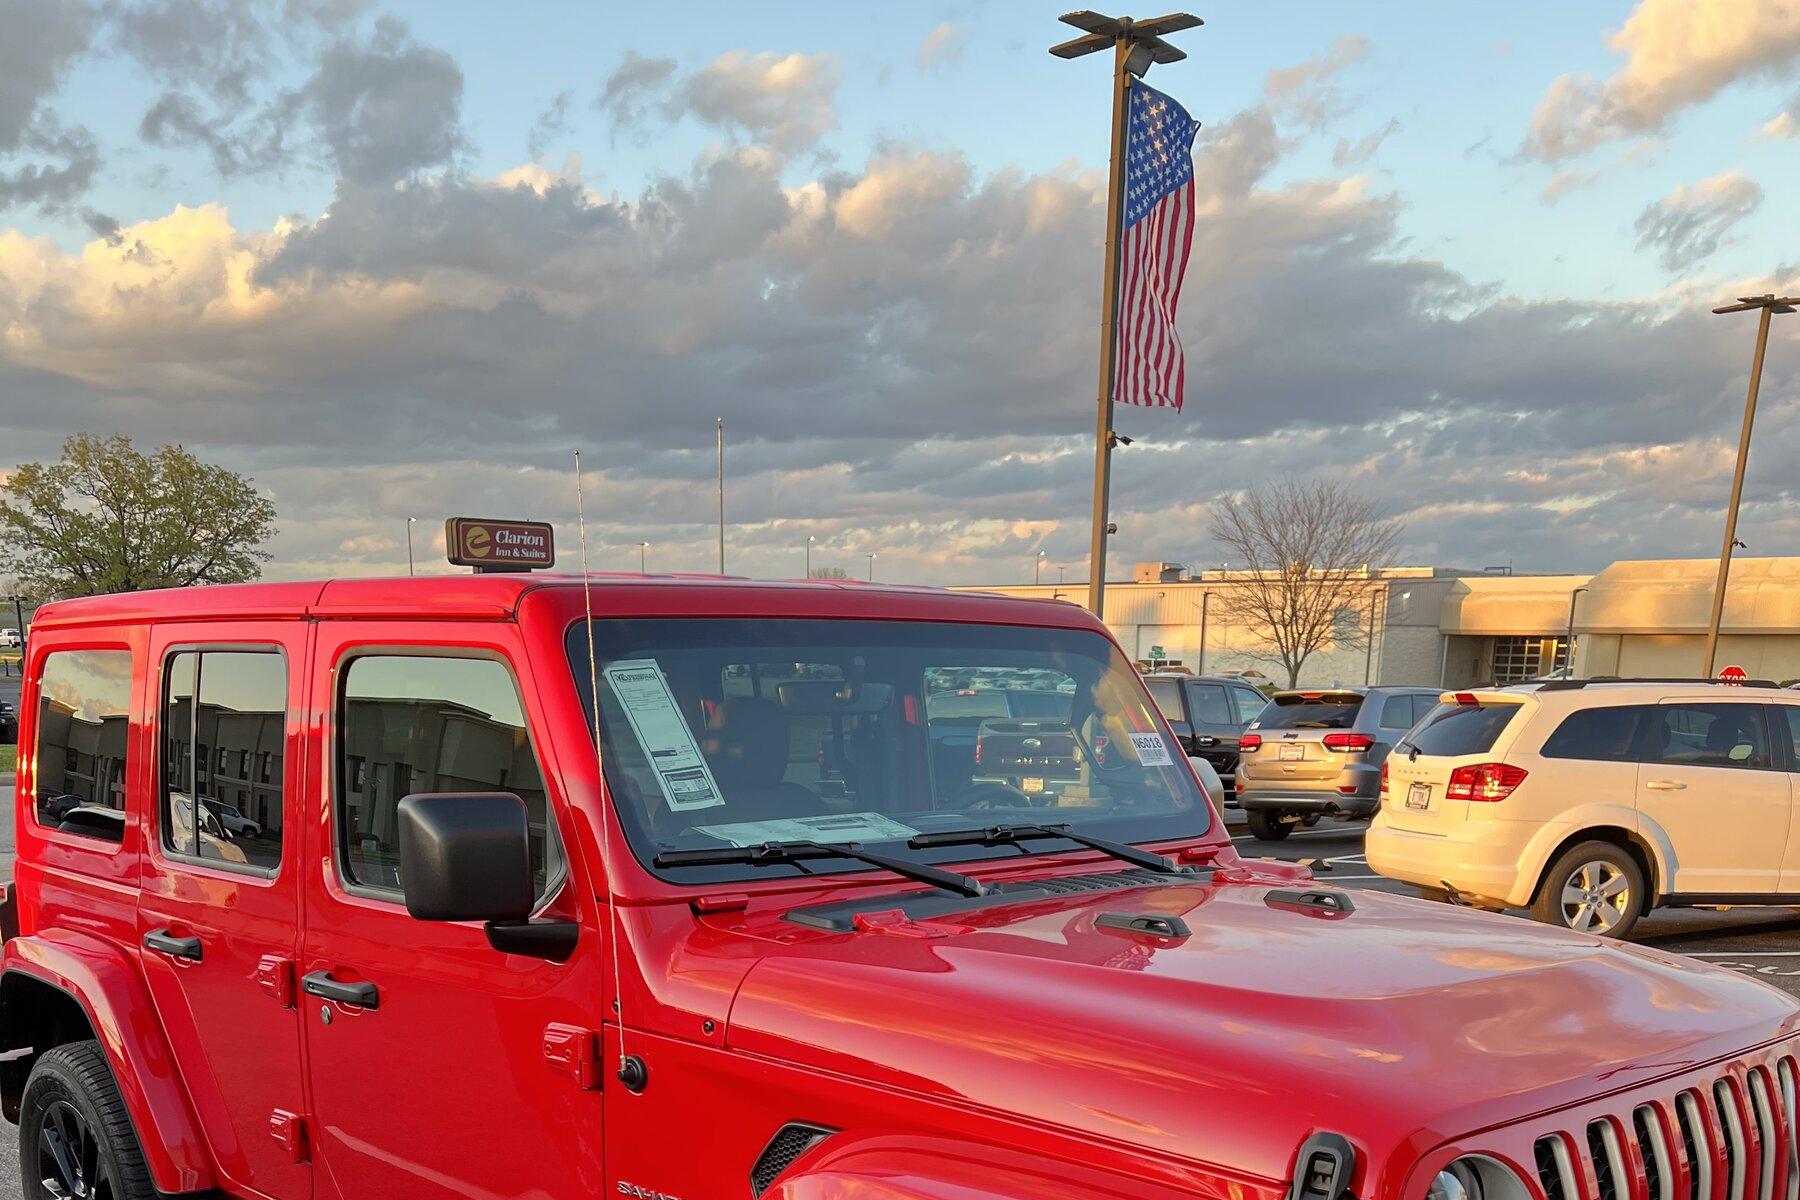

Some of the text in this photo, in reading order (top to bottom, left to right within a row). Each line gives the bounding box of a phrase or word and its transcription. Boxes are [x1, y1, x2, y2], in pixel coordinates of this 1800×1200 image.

[495, 530, 545, 547] Clarion
[495, 547, 546, 559] Inn & Suites
[1132, 737, 1162, 748] N6018
